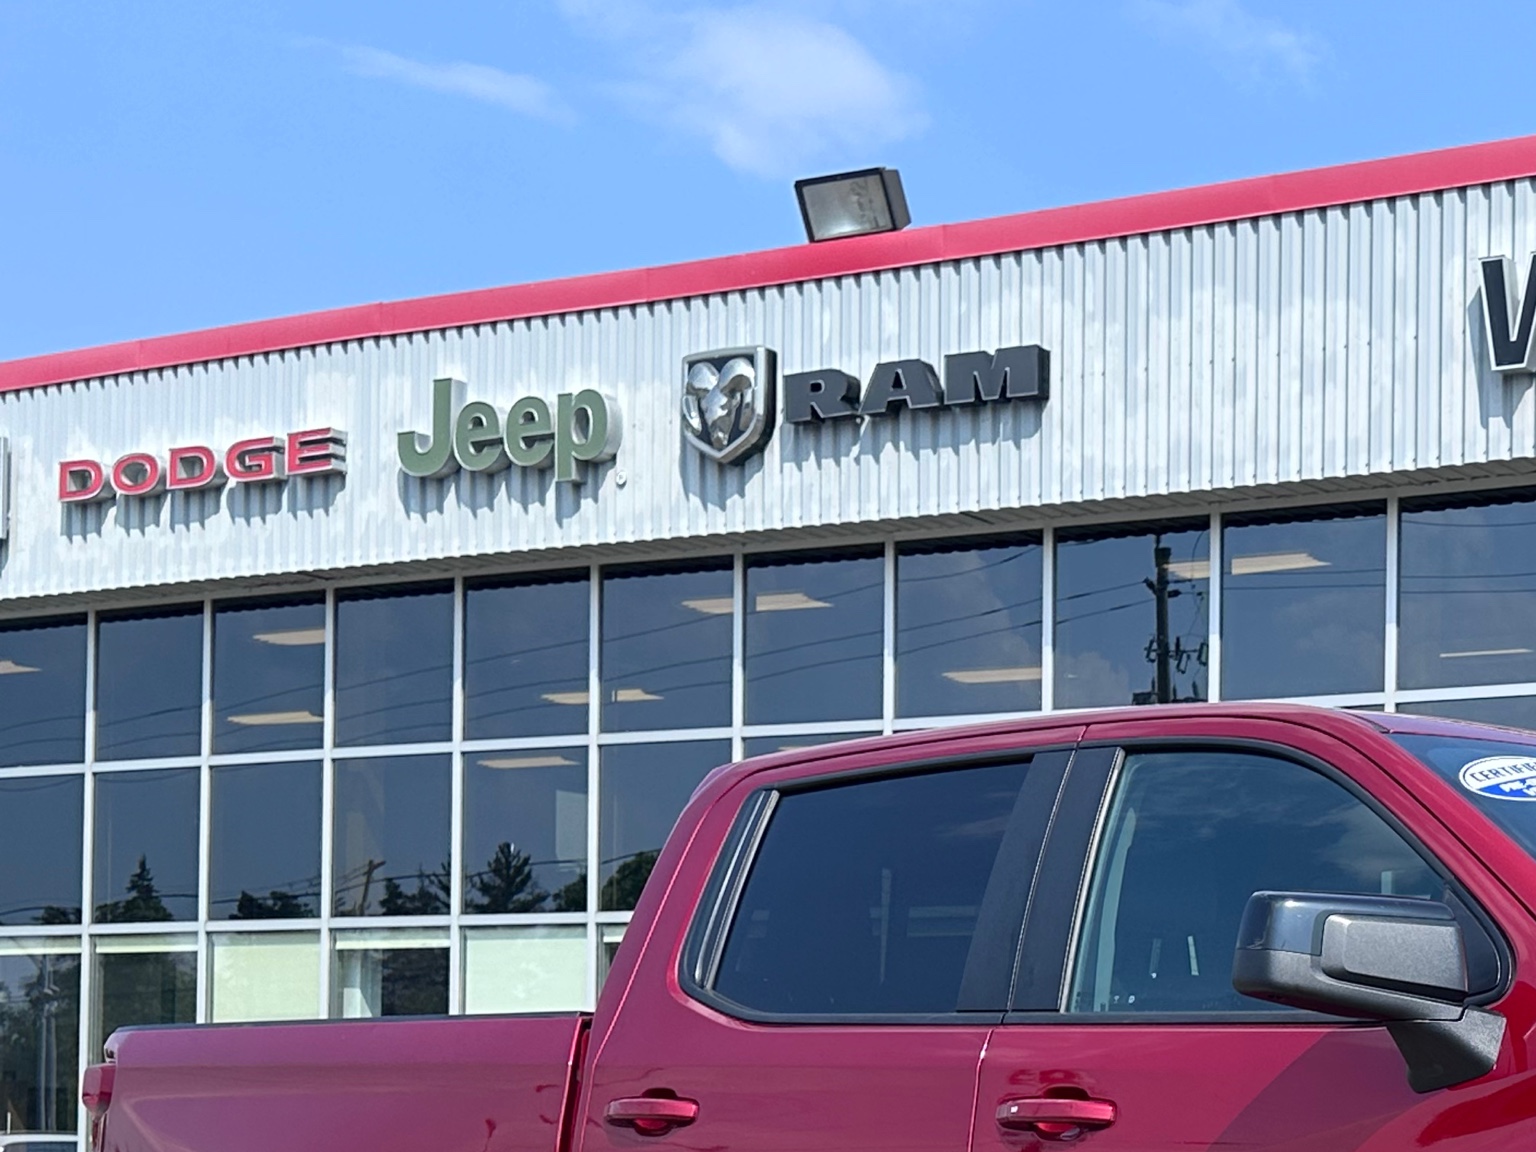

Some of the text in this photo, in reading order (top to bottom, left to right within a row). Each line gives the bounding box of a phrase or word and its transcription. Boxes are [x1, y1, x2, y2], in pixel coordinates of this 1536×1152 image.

[783, 344, 1051, 425] RAM
[58, 427, 347, 503] DODGE
[397, 378, 624, 484] Jeep
